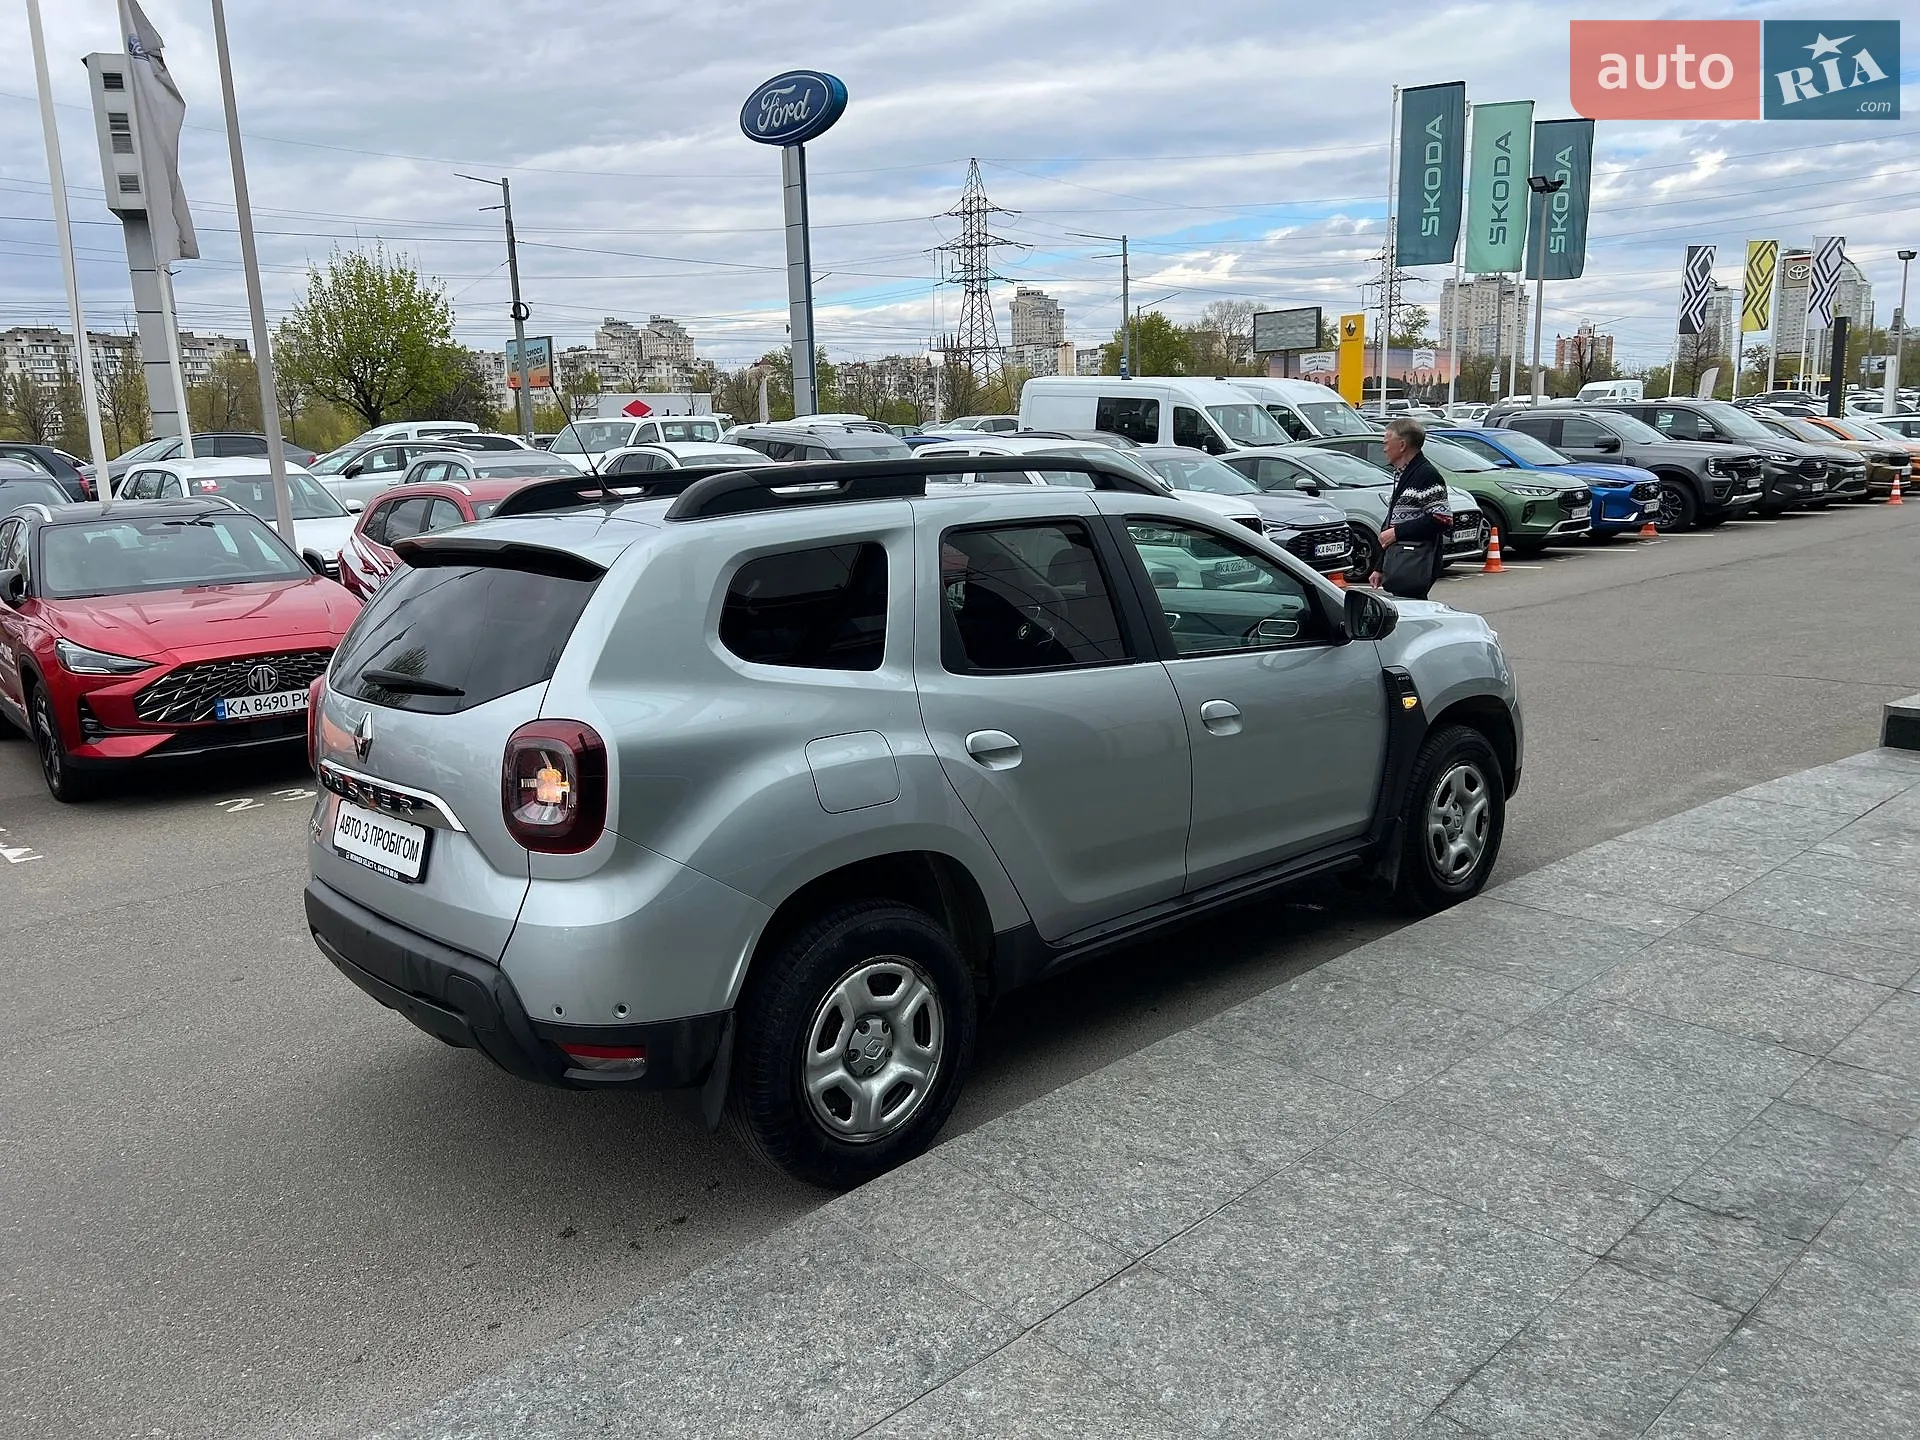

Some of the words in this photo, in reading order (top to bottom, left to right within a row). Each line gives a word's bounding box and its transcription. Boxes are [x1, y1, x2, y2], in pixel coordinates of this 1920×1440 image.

[757, 84, 812, 132] Ford
[250, 667, 276, 692] MG
[254, 694, 289, 712] 8490
[339, 813, 362, 840] АВТО
[370, 826, 419, 862] ПРОБІГОМ
